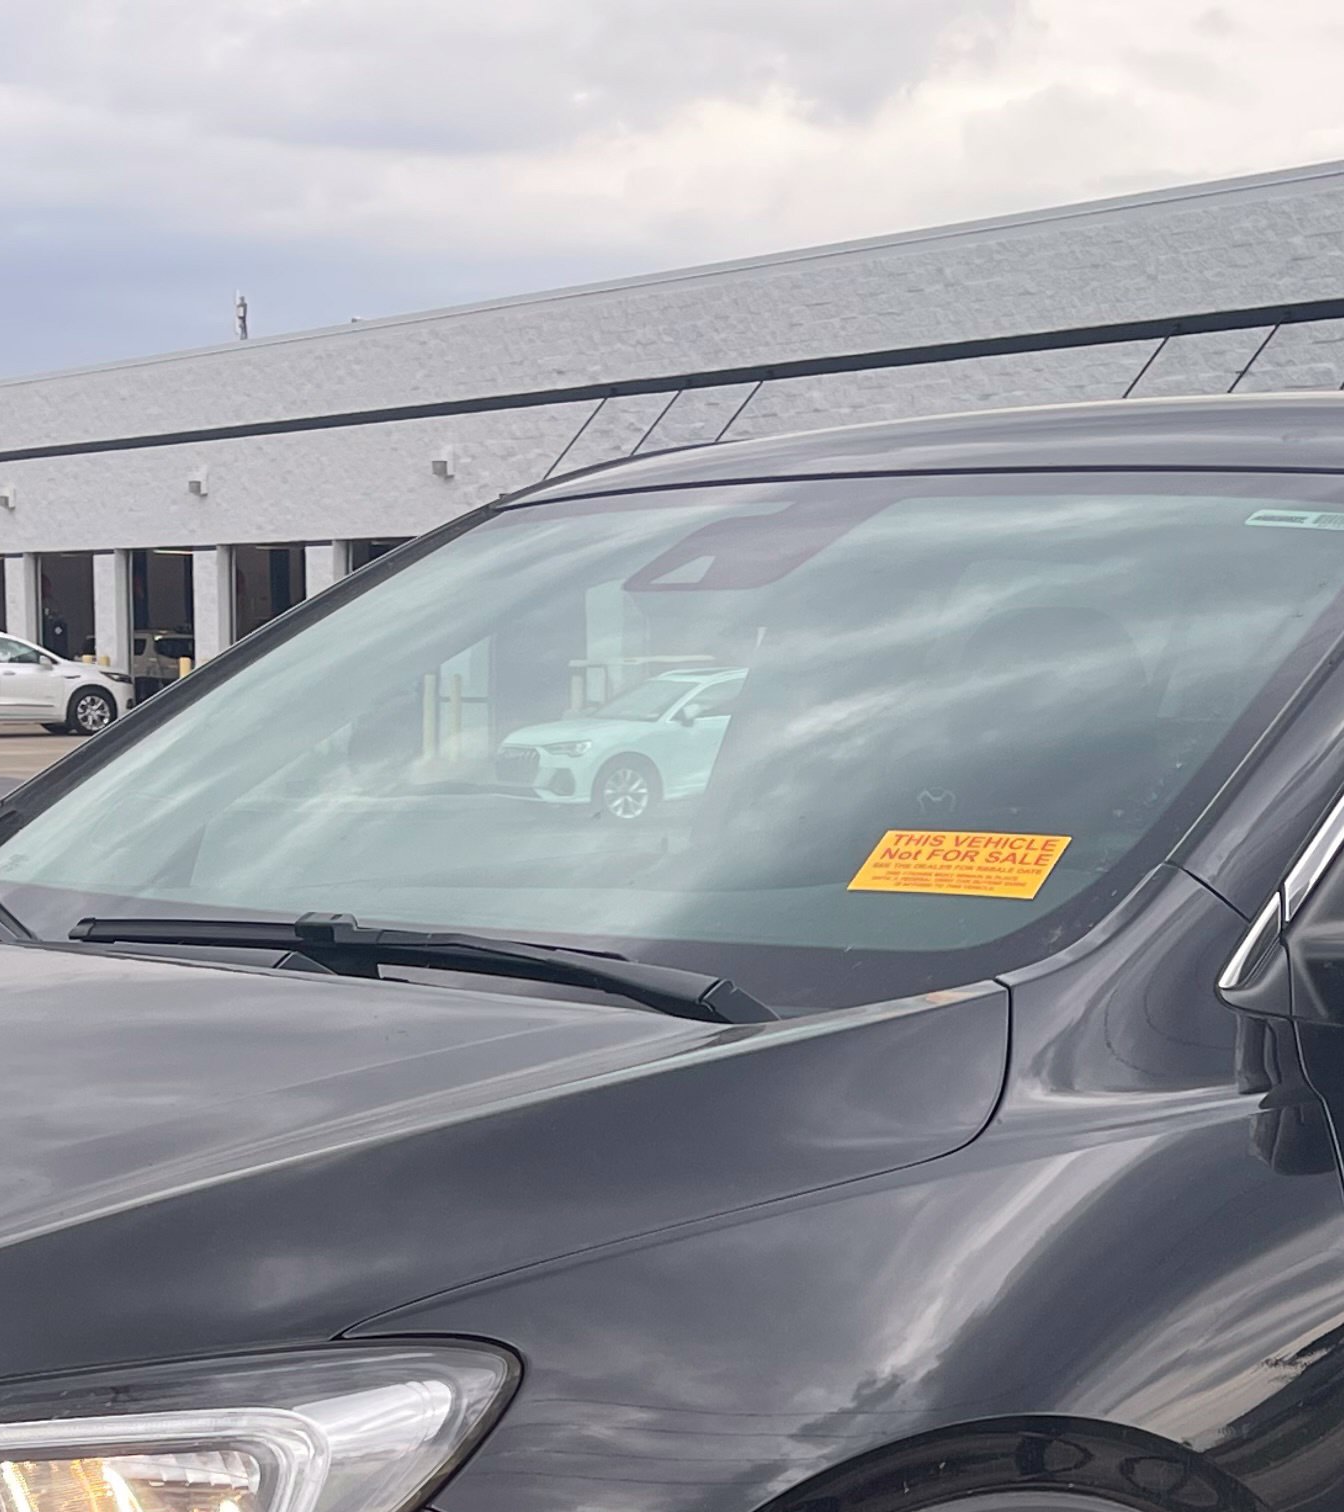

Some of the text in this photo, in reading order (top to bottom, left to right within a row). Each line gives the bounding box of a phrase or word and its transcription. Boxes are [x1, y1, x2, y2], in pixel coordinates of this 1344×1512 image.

[893, 834, 1060, 852] THIS VEHICLE
[879, 847, 1054, 866] Not FOR SALE
